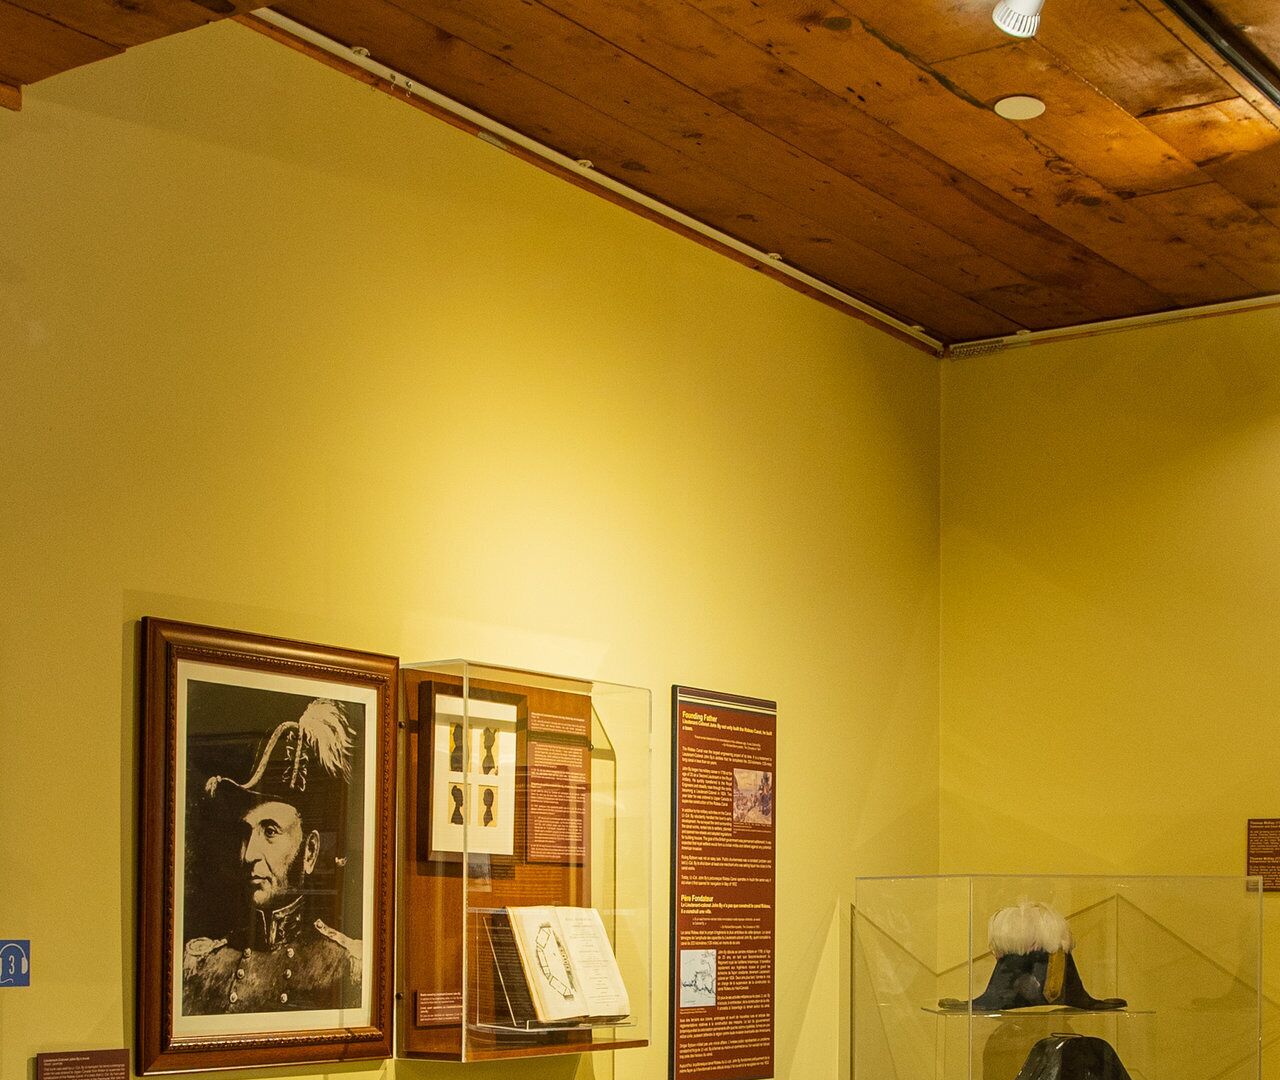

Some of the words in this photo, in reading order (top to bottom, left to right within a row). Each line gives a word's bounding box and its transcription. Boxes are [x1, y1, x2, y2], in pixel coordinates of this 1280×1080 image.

[682, 710, 703, 722] Founding
[704, 714, 717, 722] Father
[681, 894, 691, 902] Père
[9, 954, 15, 975] 3
